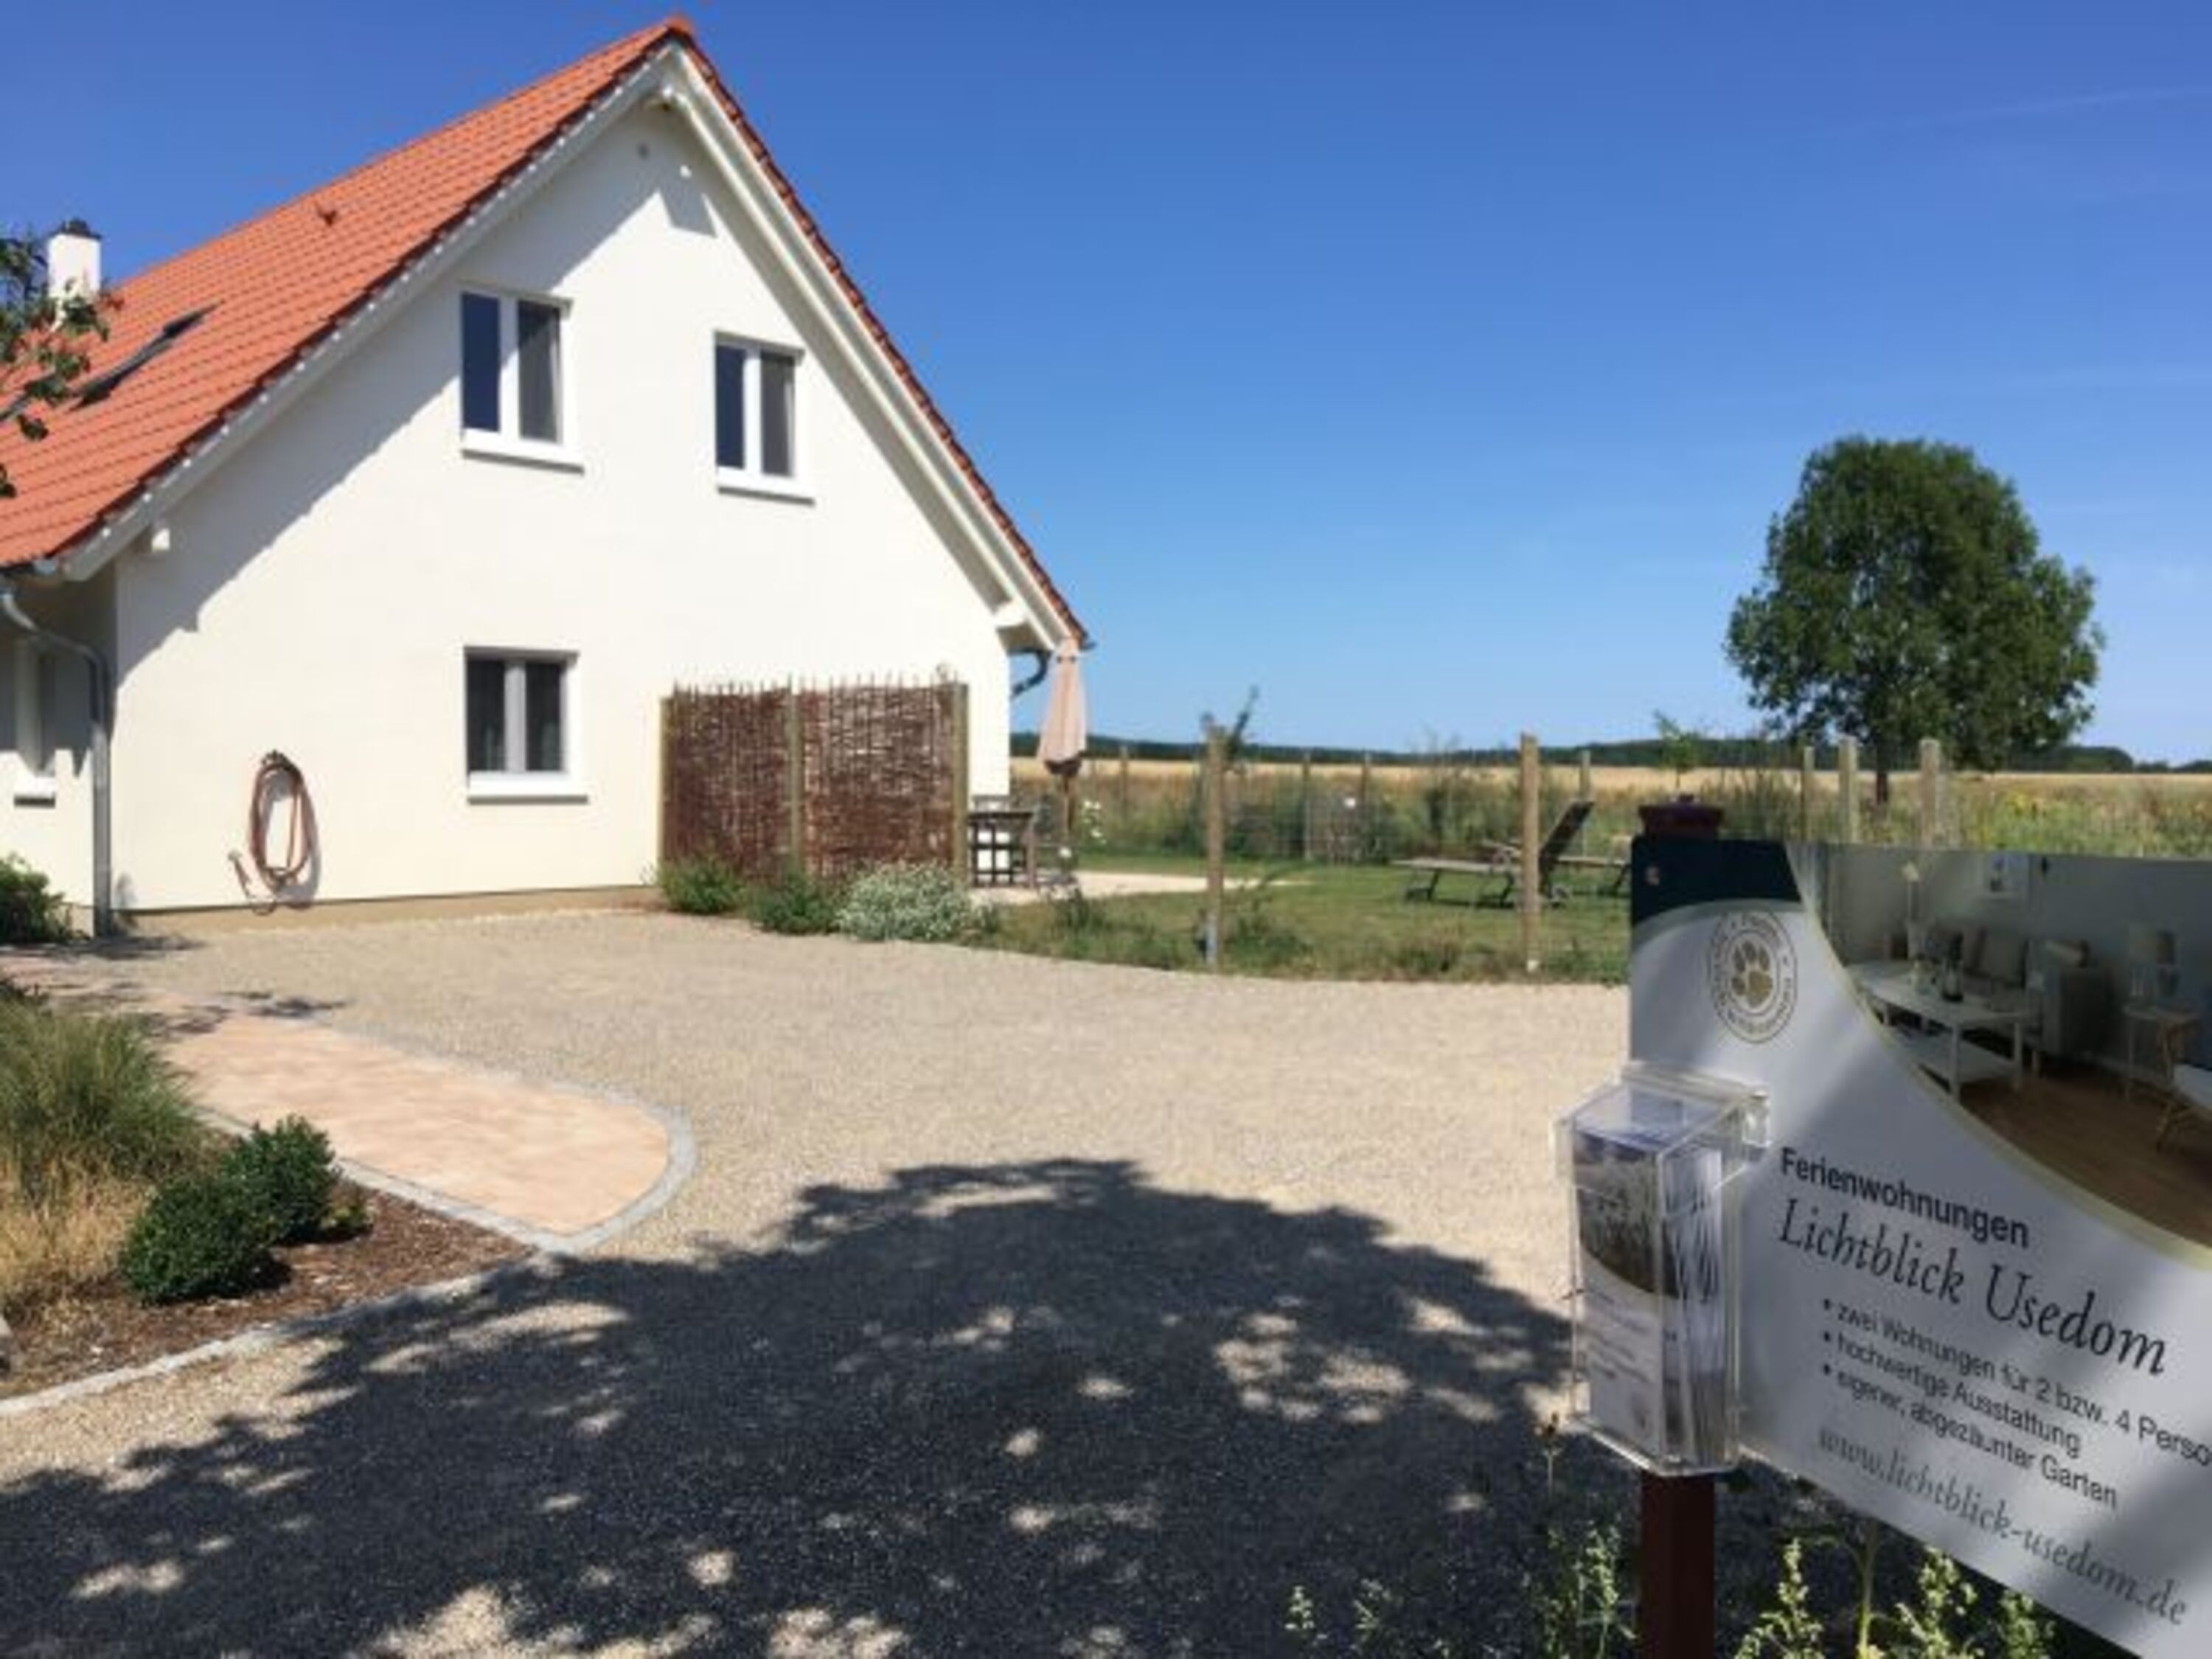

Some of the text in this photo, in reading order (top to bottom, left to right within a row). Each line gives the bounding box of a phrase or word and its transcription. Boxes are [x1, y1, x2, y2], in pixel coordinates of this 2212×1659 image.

[1781, 1146, 2030, 1249] Ferienwohnungen
[1779, 1197, 2165, 1375] Lichtblick Usedom
[1838, 1305, 2212, 1467] zwei Wohnungen für 2 bzw. 4 Perso
[1838, 1333, 2080, 1459] hochwertige Ausstattung
[1838, 1370, 1905, 1418] eigener,
[2042, 1454, 2118, 1509] Garten
[1818, 1427, 2186, 1625] www.lichtblick-usedom.de
